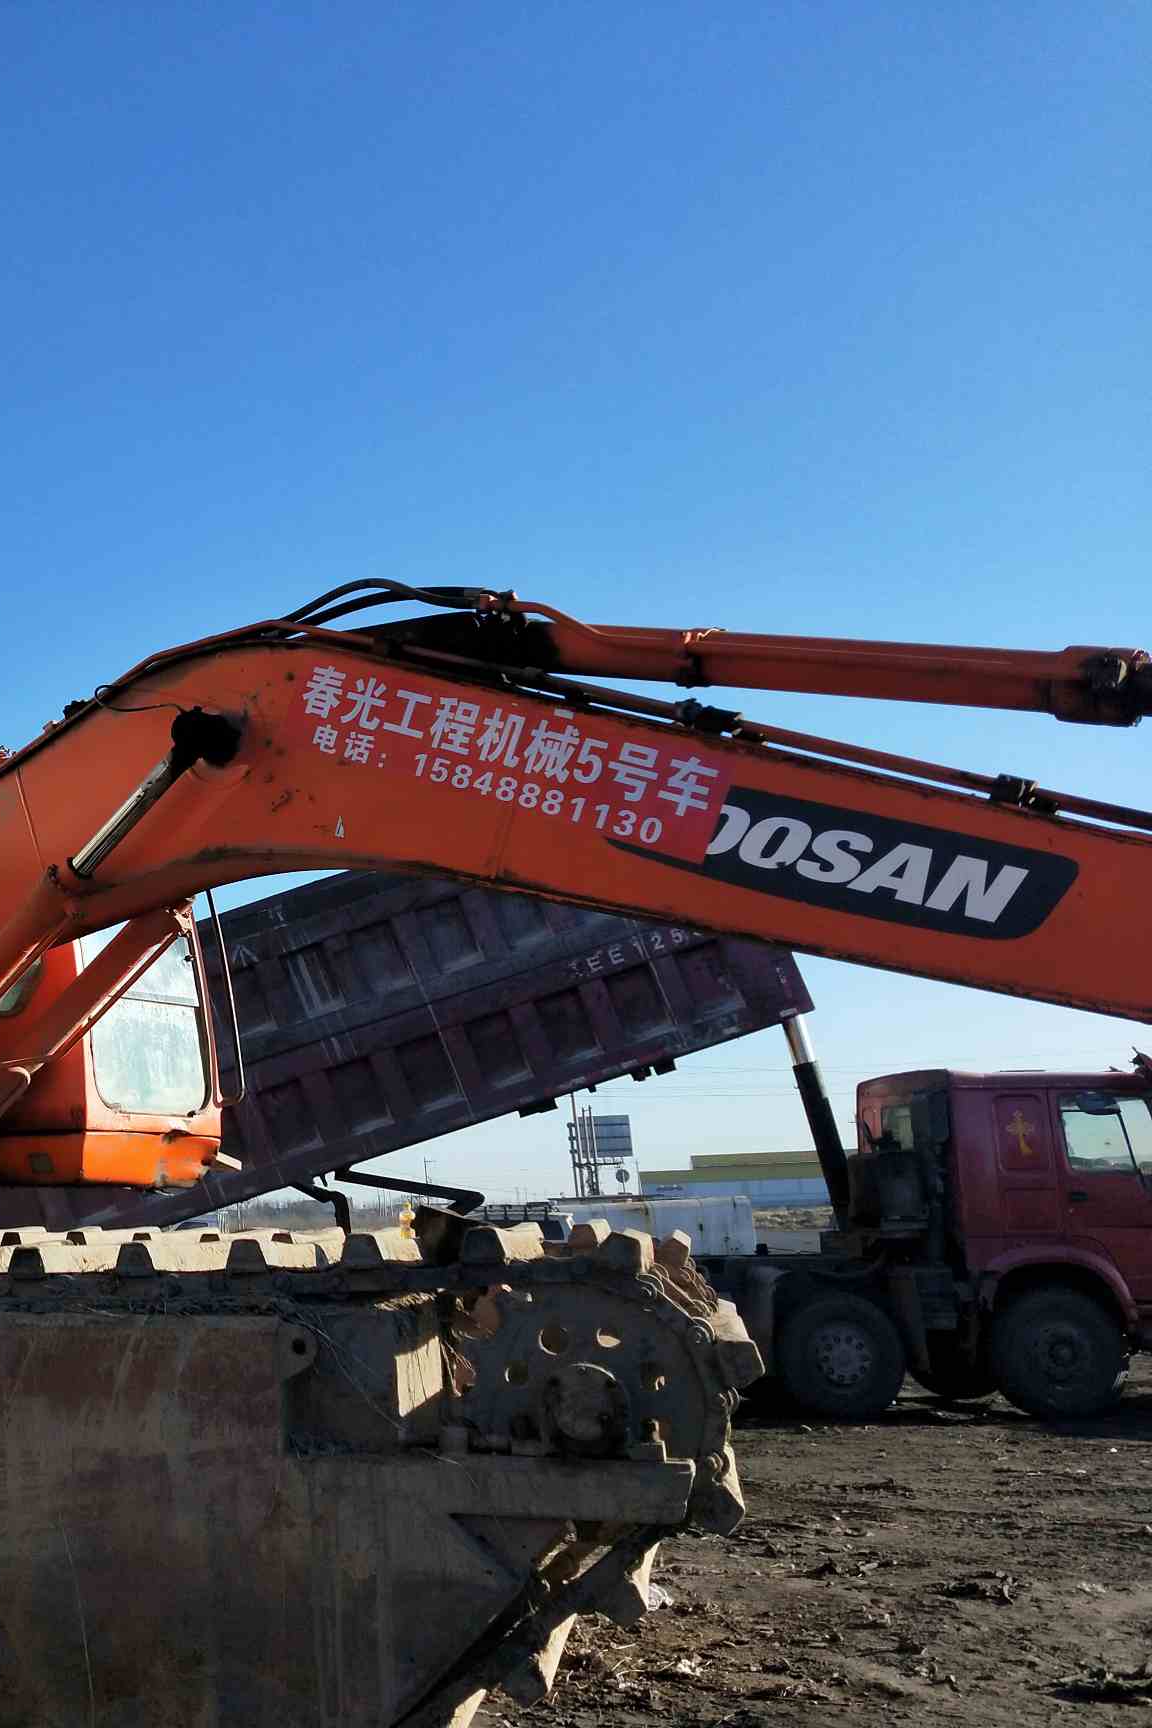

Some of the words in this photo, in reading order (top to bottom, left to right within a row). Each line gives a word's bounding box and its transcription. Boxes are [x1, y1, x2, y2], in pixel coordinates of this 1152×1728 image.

[302, 665, 721, 817] 春光工程机械5号车
[414, 753, 663, 844] 15848881130
